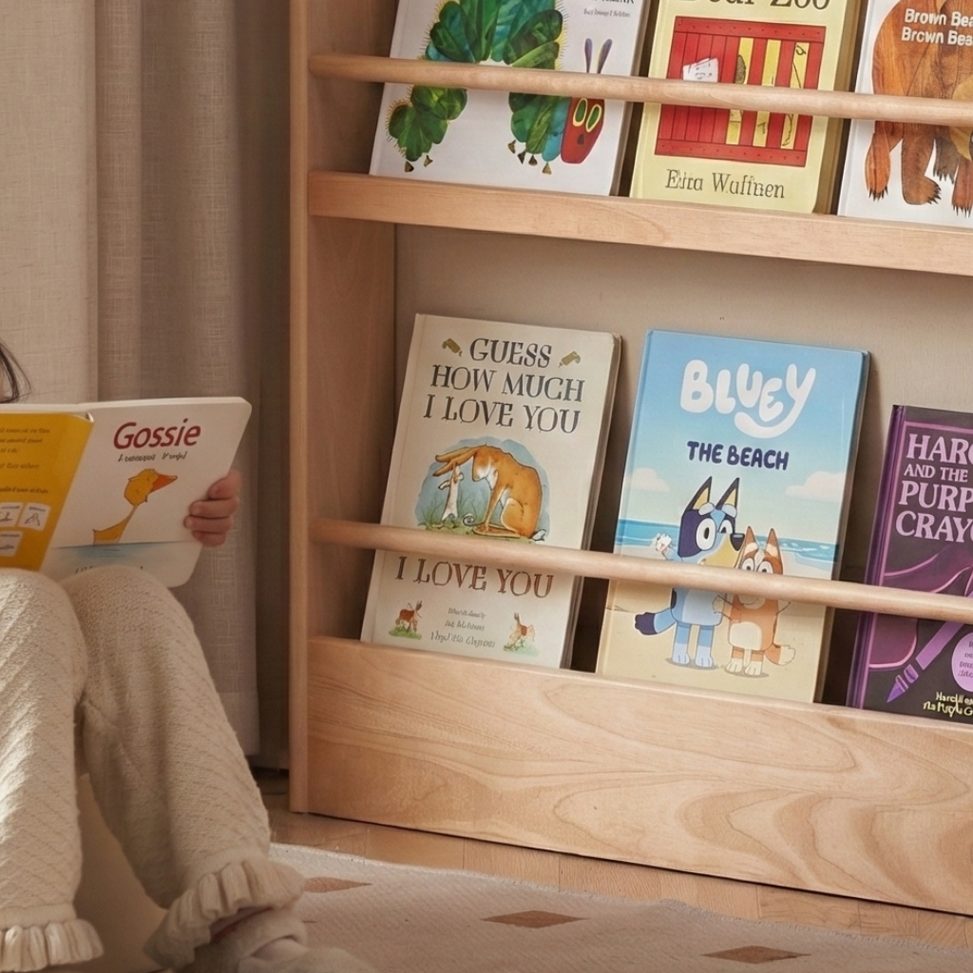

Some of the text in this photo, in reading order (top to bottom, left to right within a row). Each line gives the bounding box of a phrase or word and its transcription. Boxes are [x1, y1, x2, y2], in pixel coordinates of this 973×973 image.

[904, 8, 946, 26] Brown
[469, 337, 552, 369] GUESS
[430, 364, 586, 403] HOW MUCH
[423, 394, 581, 434] I LOVE YOU
[113, 418, 202, 449] Gossie
[687, 441, 790, 471] THE BEACH
[904, 463, 968, 483] AND THE
[396, 556, 554, 599] I LOVE YOU
